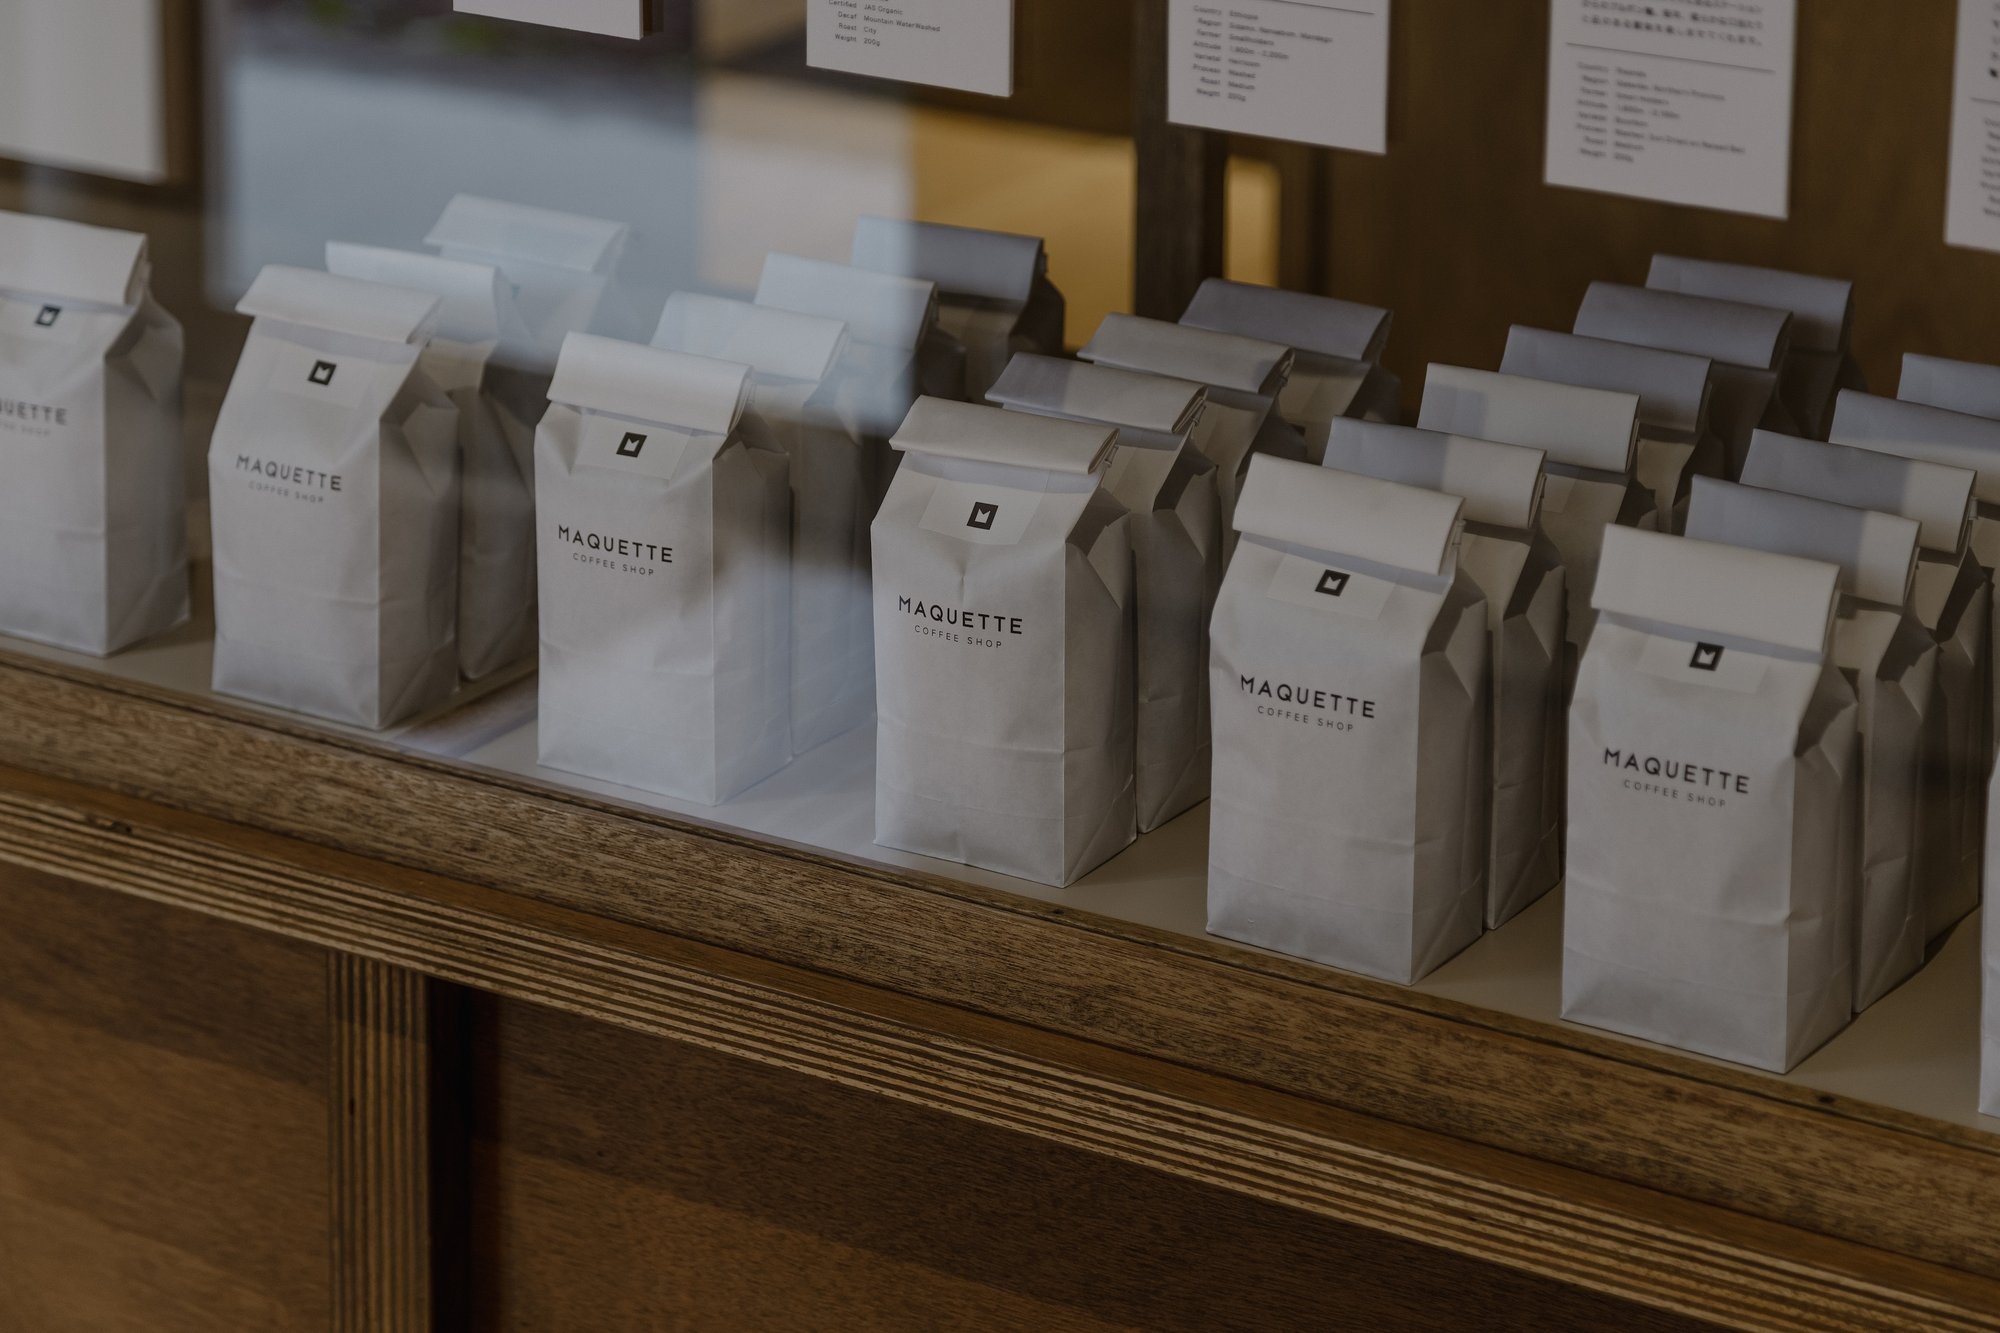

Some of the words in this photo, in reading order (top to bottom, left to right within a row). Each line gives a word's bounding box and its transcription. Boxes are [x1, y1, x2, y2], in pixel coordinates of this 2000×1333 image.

[838, 11, 857, 19] Decaf
[864, 15, 893, 25] Mountain
[879, 5, 904, 15] Organic
[834, 33, 857, 42] Weight
[864, 37, 881, 47] 200g
[839, 22, 857, 31] Roast
[864, 26, 877, 35] City
[0, 397, 68, 427] UETTE
[235, 454, 343, 493] MAQUETTE
[248, 480, 289, 498] COFFEE
[295, 491, 325, 504] SHOP
[558, 523, 673, 564] MAQUETTE
[573, 553, 616, 570] COFFEE
[622, 564, 655, 577] SHOP
[899, 595, 1023, 635] MAQUETTE
[914, 625, 959, 643] COFFEE
[967, 637, 1002, 649] SHOP
[1240, 674, 1376, 719] MAQUETTE
[1257, 705, 1309, 724] COFFEE
[1317, 718, 1354, 733] SHOP
[1604, 747, 1750, 795] MAQUETTE
[1623, 779, 1679, 800] COFFEE
[1687, 792, 1726, 809] SHOP
